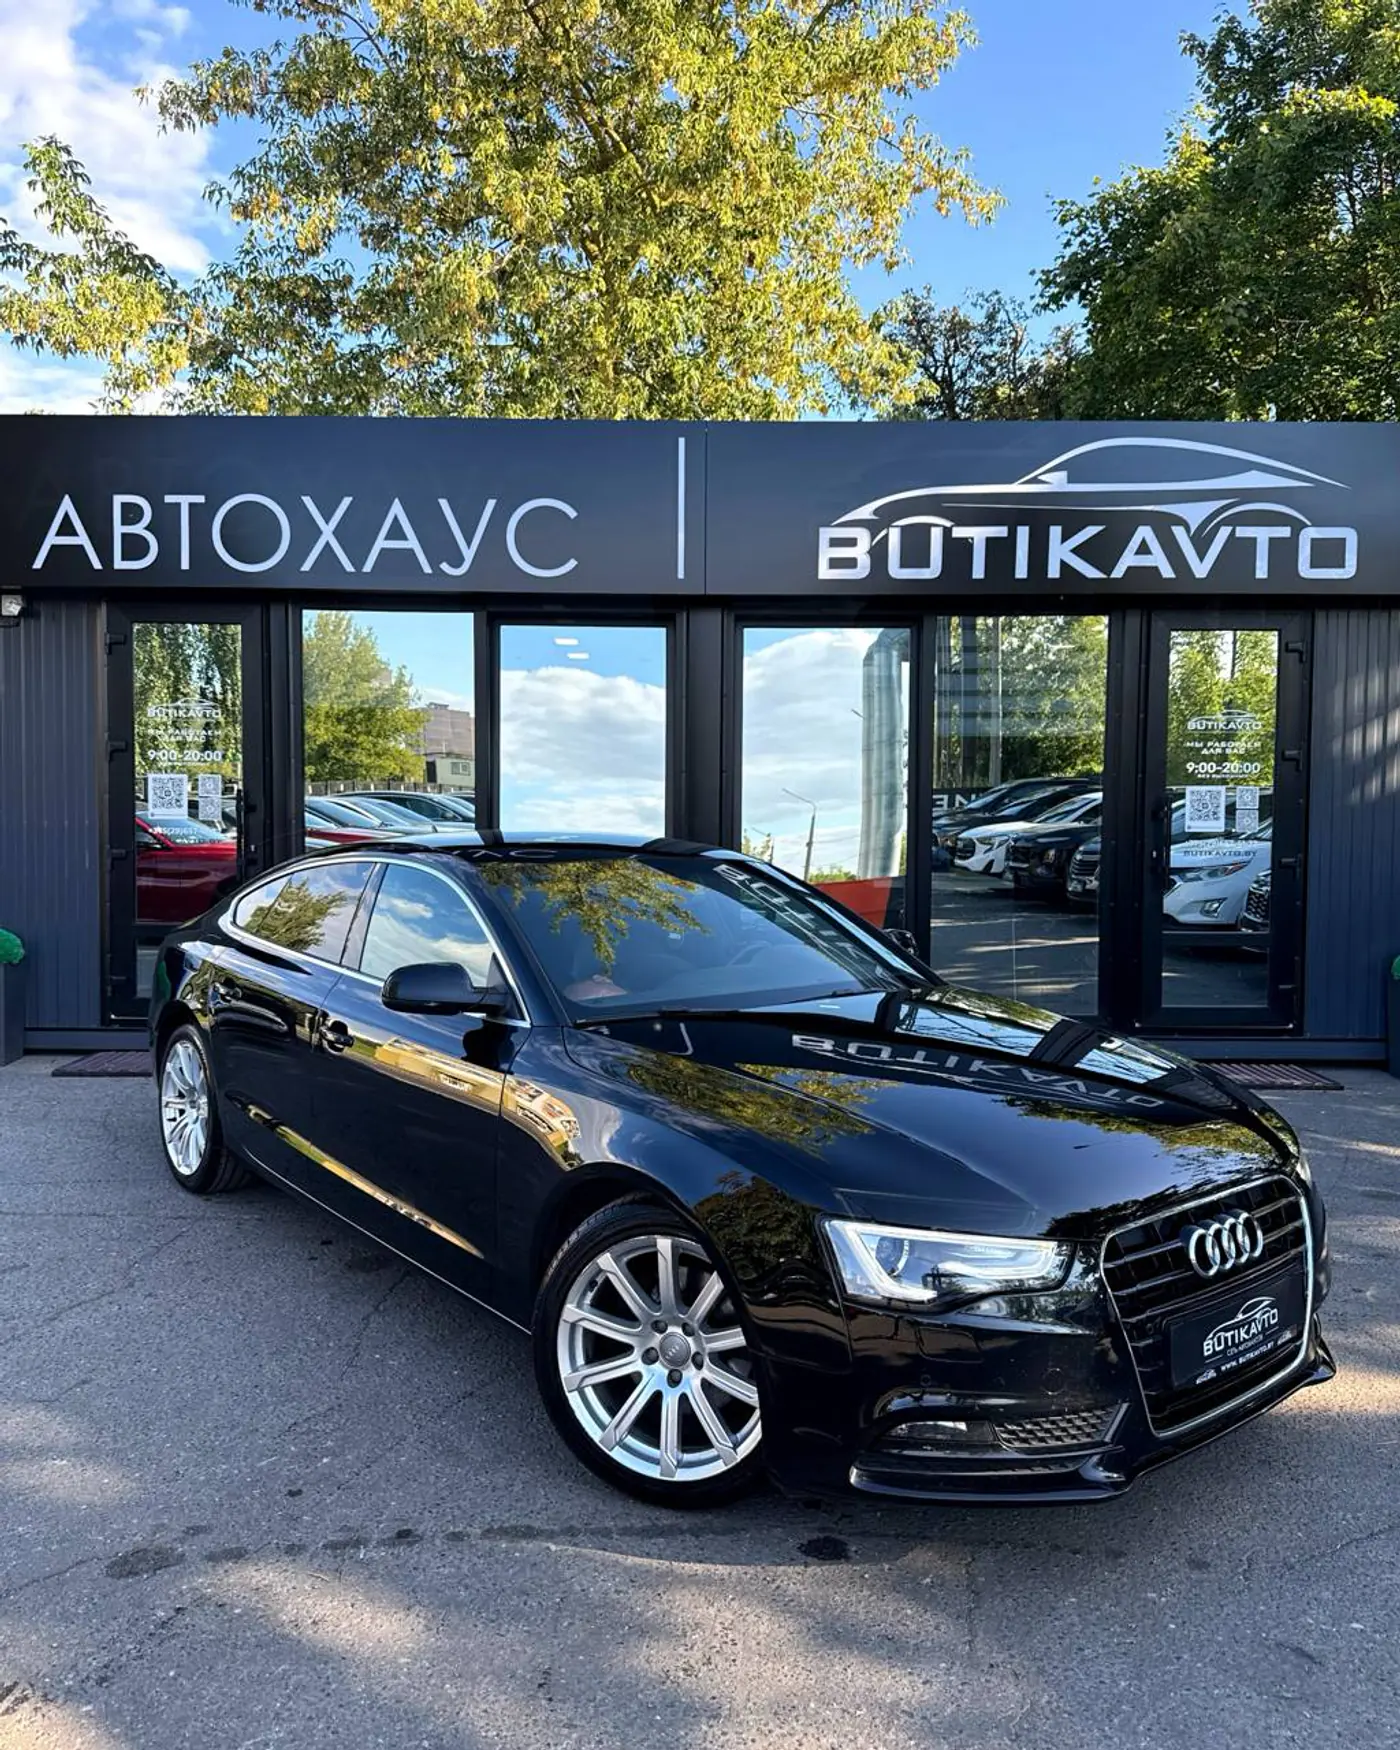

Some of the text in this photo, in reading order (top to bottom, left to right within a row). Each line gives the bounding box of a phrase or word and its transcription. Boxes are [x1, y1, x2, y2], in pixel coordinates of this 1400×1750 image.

[32, 493, 579, 578] АВТОХАУС
[817, 523, 1359, 580] BUTIKAVTO
[1187, 720, 1262, 730] BUTIKAVTO
[1186, 762, 1261, 773] 9:00-20:00
[1203, 1308, 1278, 1357] BUTIKAVTO
